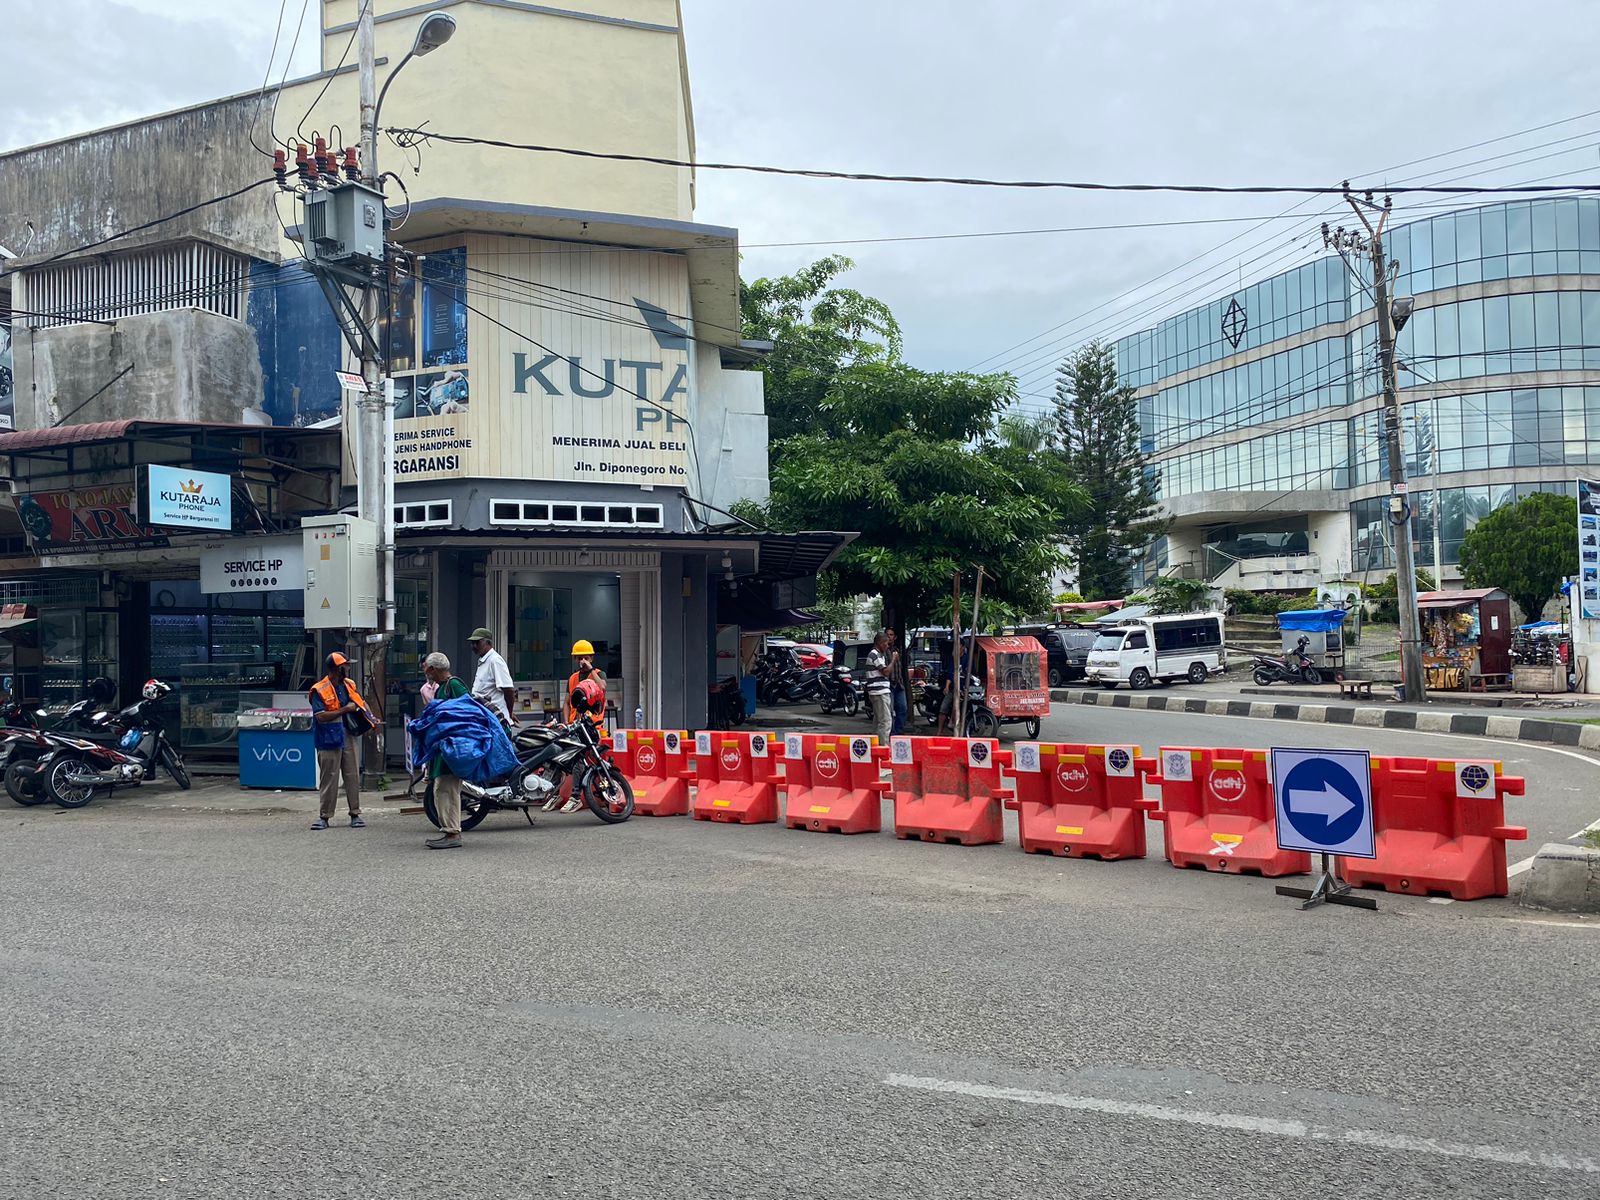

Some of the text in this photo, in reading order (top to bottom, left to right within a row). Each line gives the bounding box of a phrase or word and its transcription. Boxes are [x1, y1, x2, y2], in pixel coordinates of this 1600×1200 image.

[420, 427, 455, 439] SERVICE
[394, 439, 472, 454] JENIS HANDPHONE
[552, 436, 686, 451] MENERIMA JUAL BELI
[574, 461, 596, 472] Jln.
[600, 462, 666, 476] Diponegoro
[51, 490, 97, 509] TOKO
[160, 491, 221, 507] KUTARAJA
[178, 503, 205, 512] PHONE
[224, 559, 283, 573] SERVICE HP
[252, 743, 302, 762] vivo
